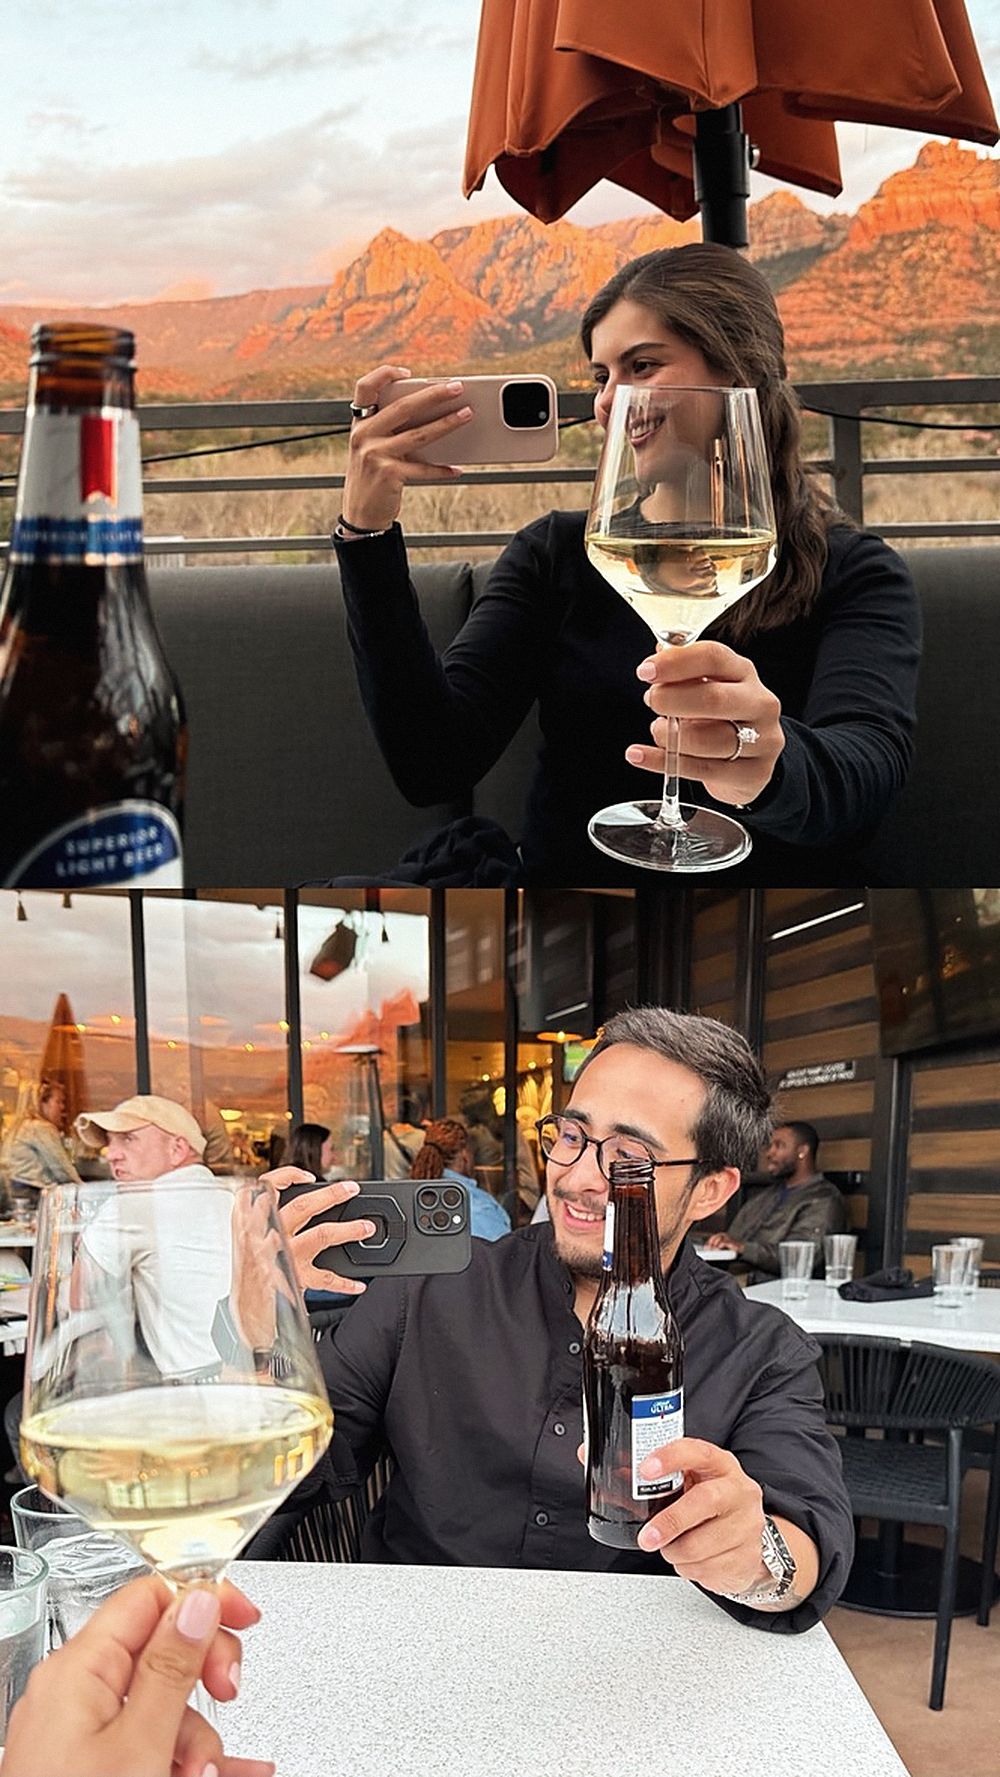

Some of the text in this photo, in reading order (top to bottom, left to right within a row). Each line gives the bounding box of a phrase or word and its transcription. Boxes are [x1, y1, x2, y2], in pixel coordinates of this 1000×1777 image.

[65, 825, 158, 856] SUPERIOR
[55, 842, 163, 877] LIGHT BEER
